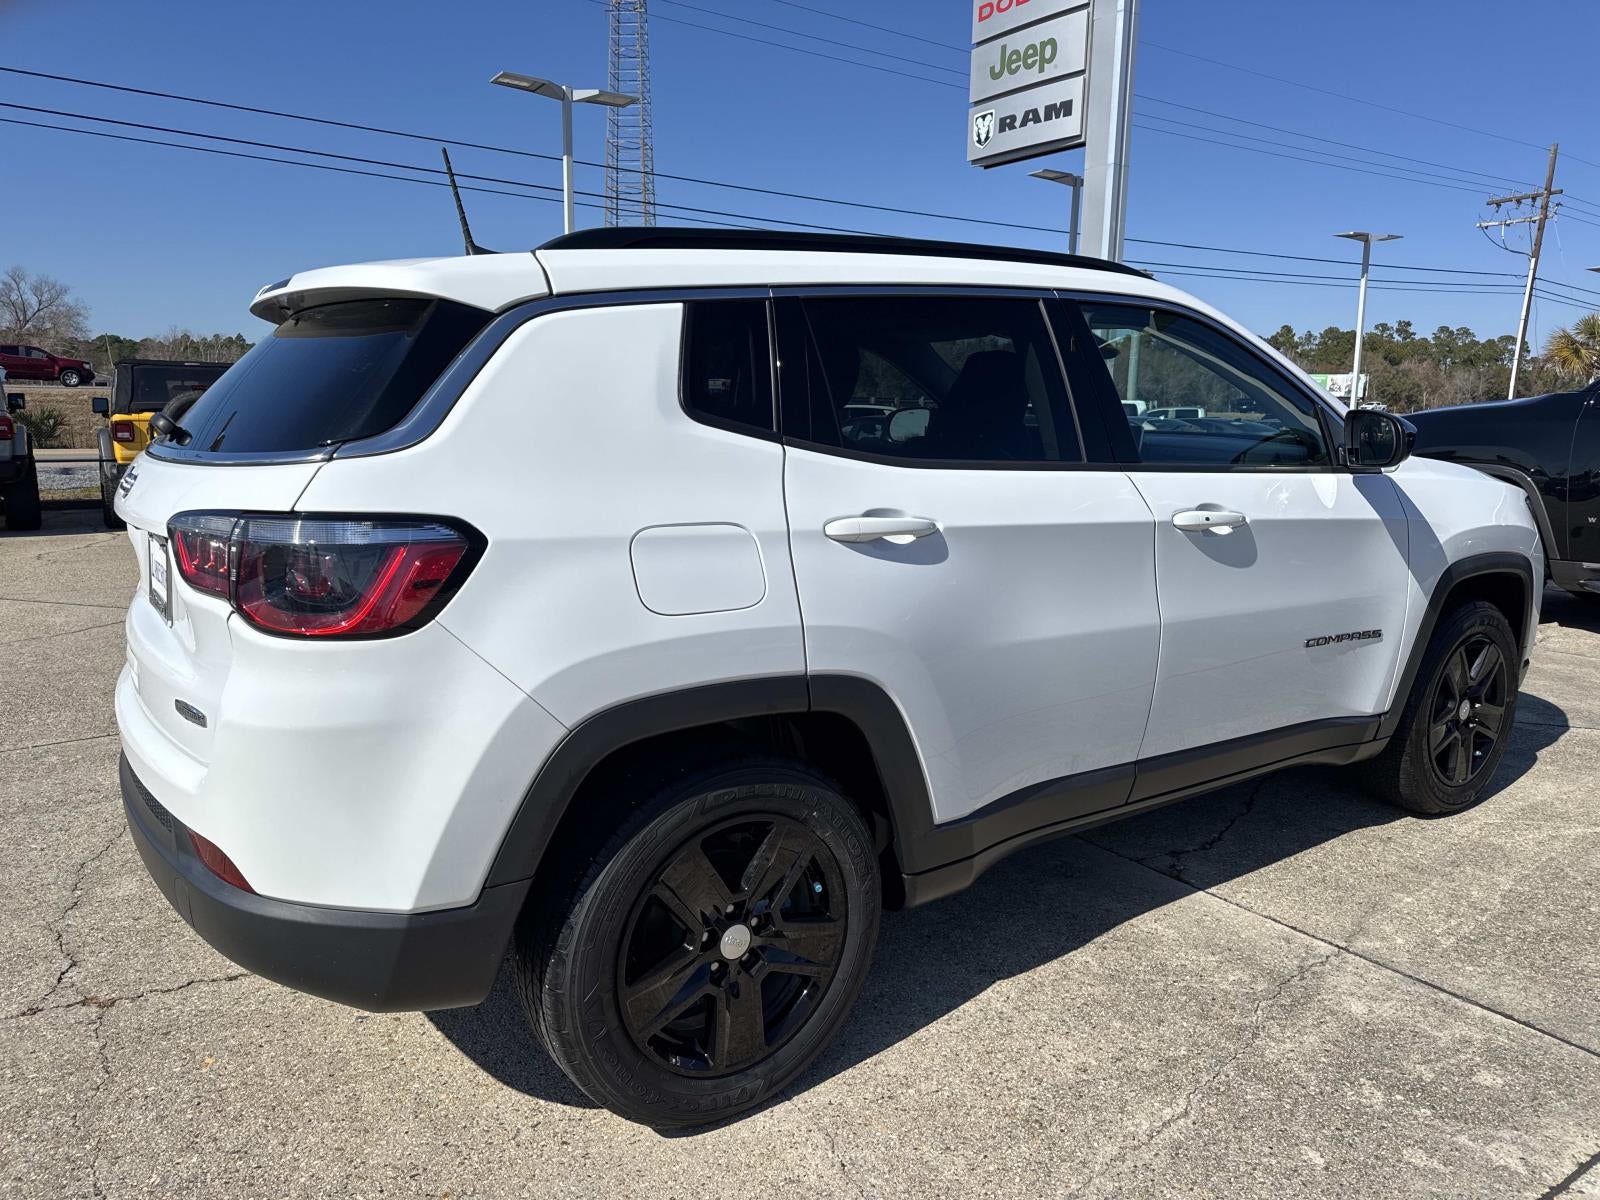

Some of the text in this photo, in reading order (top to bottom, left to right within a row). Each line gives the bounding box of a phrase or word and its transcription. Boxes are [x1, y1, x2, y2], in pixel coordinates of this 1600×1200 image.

[978, 0, 1031, 22] DO
[990, 37, 1057, 80] Jeep
[998, 99, 1073, 134] RAM
[1305, 629, 1382, 648] COMPASS
